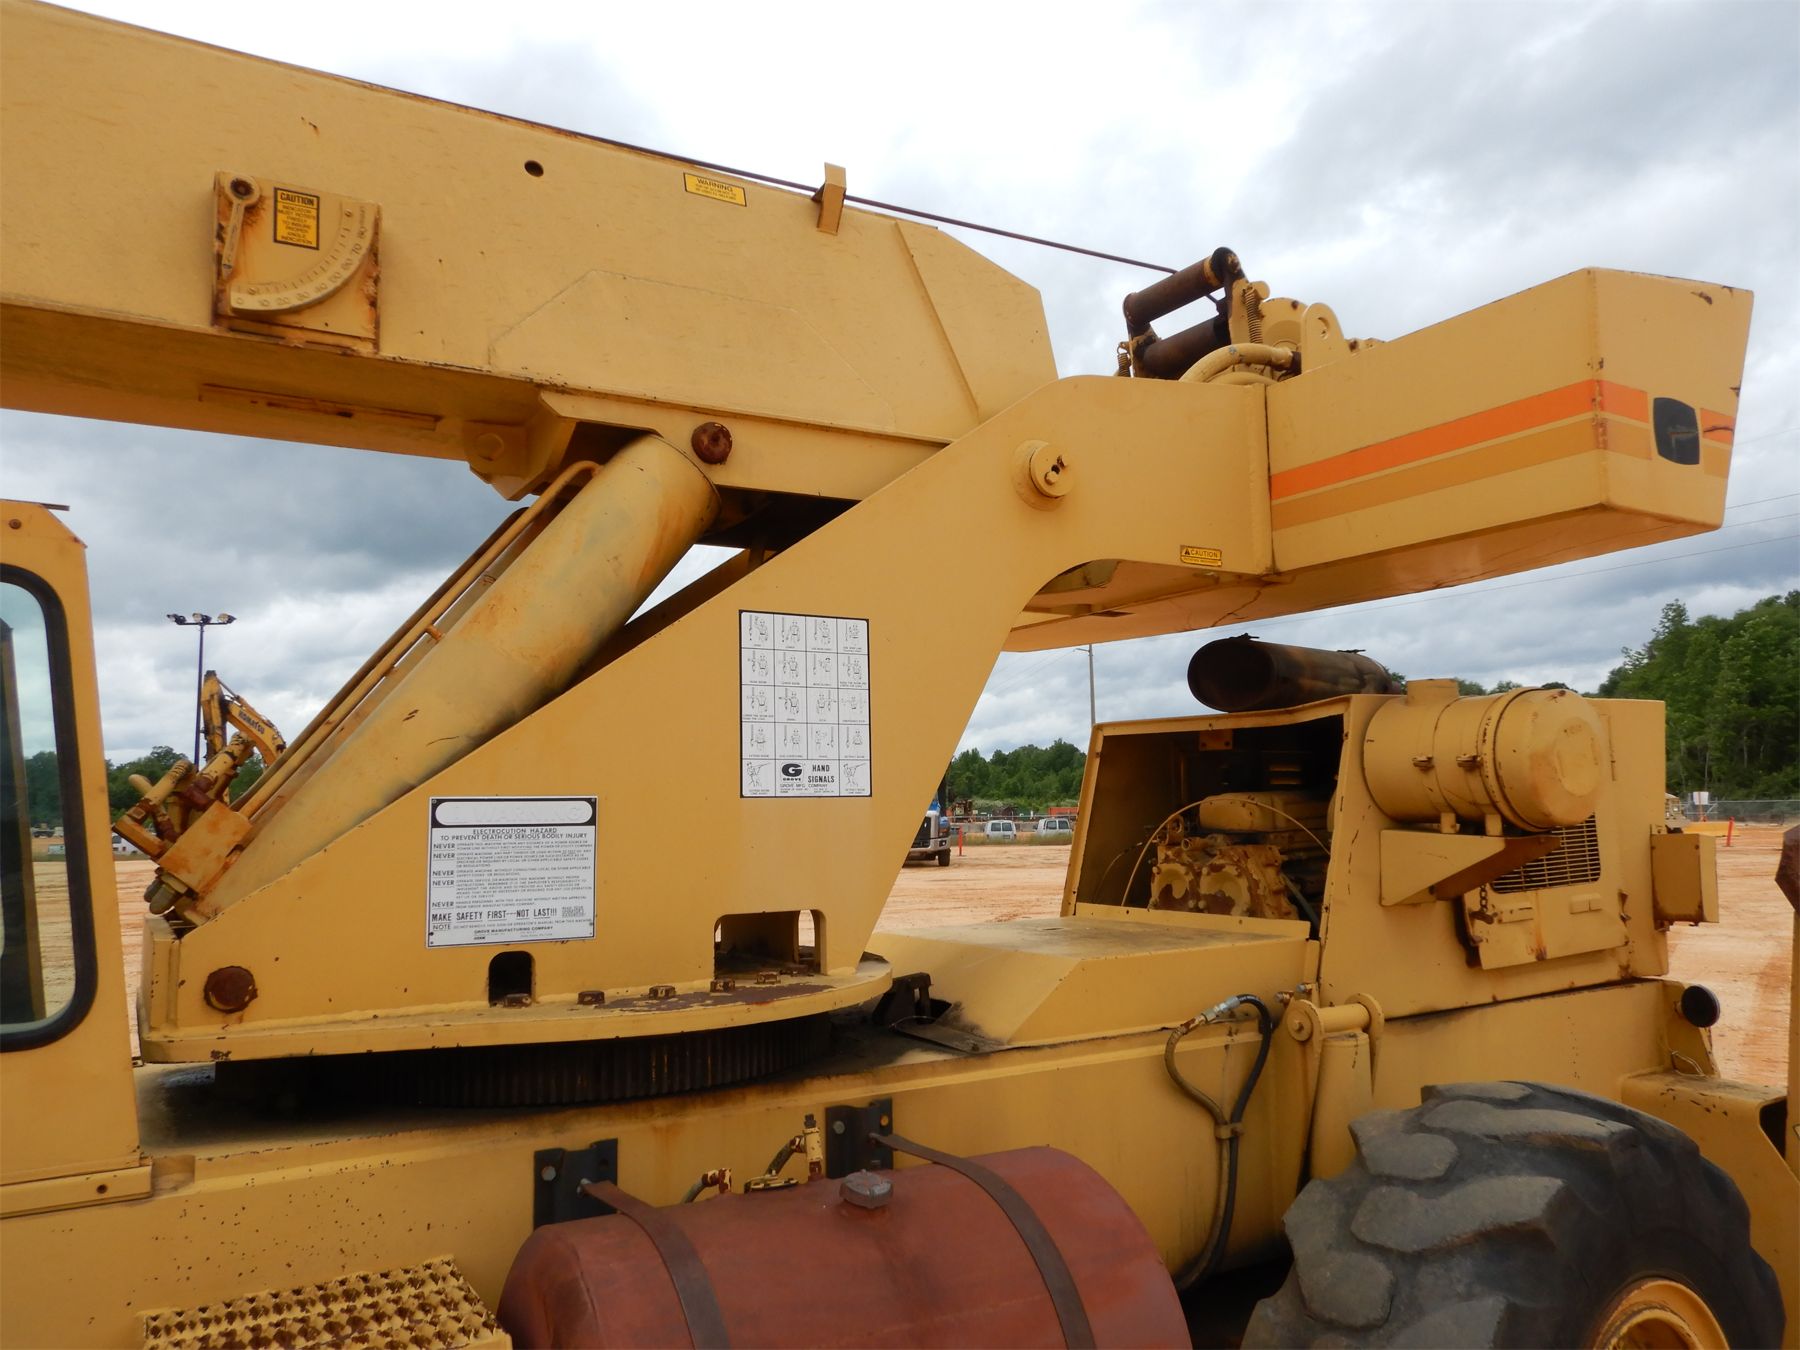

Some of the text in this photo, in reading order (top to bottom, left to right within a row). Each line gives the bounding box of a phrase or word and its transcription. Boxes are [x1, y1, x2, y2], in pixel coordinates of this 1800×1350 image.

[280, 192, 315, 206] CAUTION
[1190, 549, 1218, 558] CAUTION
[239, 711, 265, 734] KOMATSU
[812, 764, 830, 772] HAND
[807, 775, 835, 783] SIGNALS
[431, 912, 452, 922] MAKE
[456, 911, 483, 921] SAFETY
